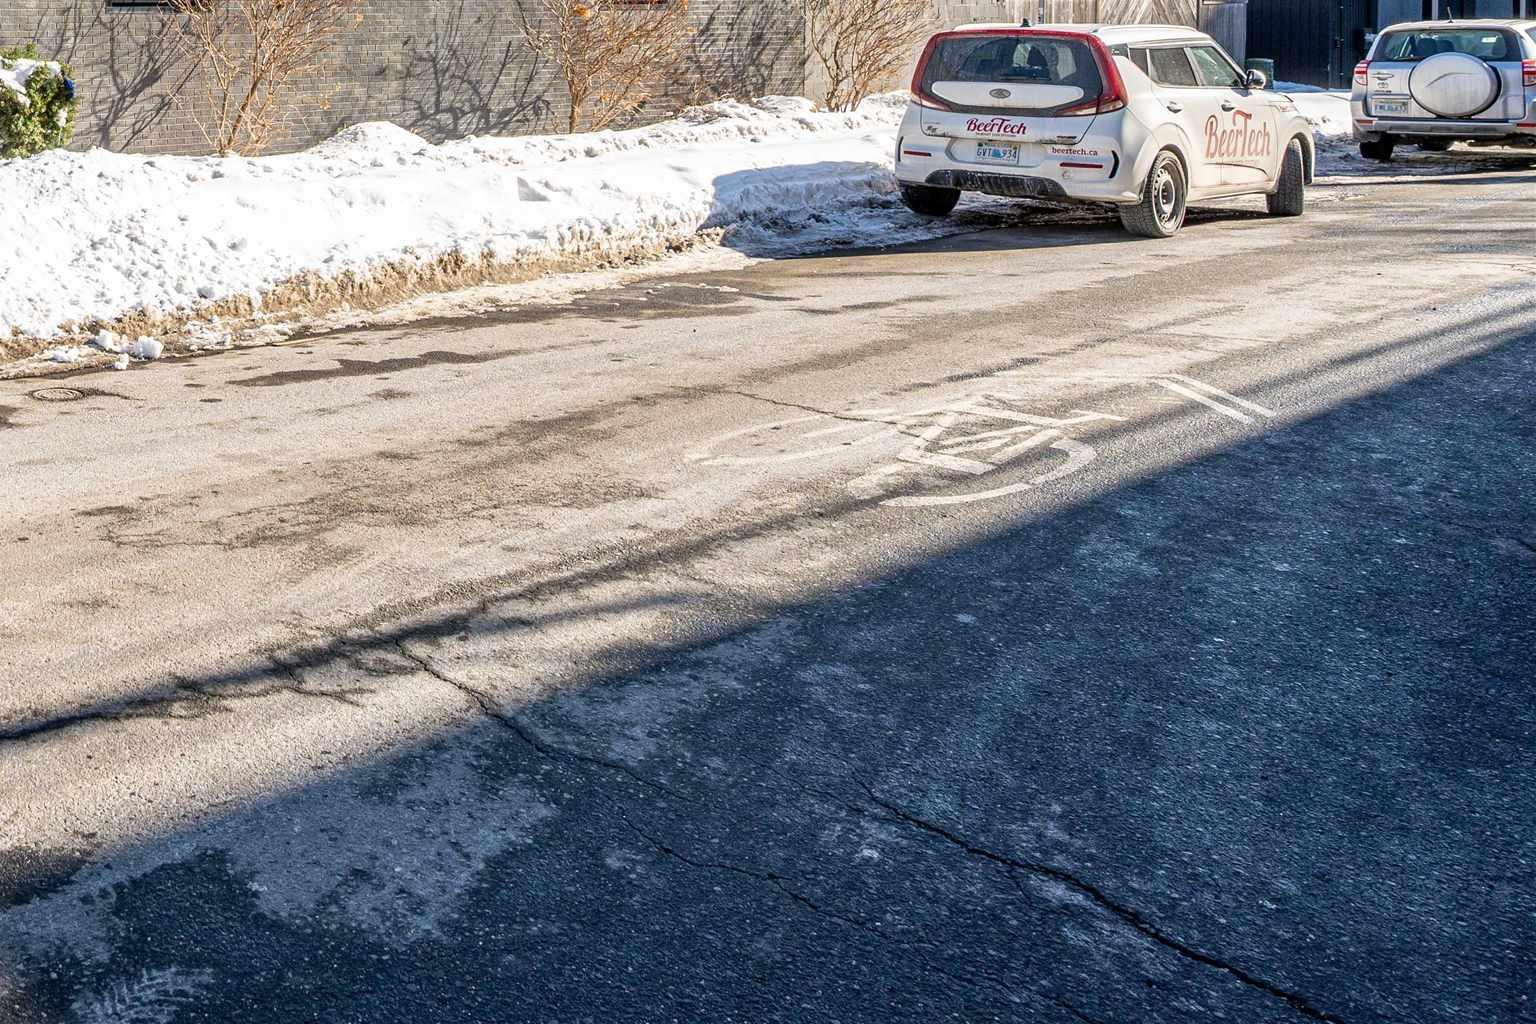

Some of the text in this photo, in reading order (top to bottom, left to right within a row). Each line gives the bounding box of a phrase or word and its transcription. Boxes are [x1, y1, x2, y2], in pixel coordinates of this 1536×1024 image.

[966, 117, 1027, 135] BeerTech
[1205, 110, 1270, 158] BeerTech
[1051, 147, 1098, 156] beertech.ca
